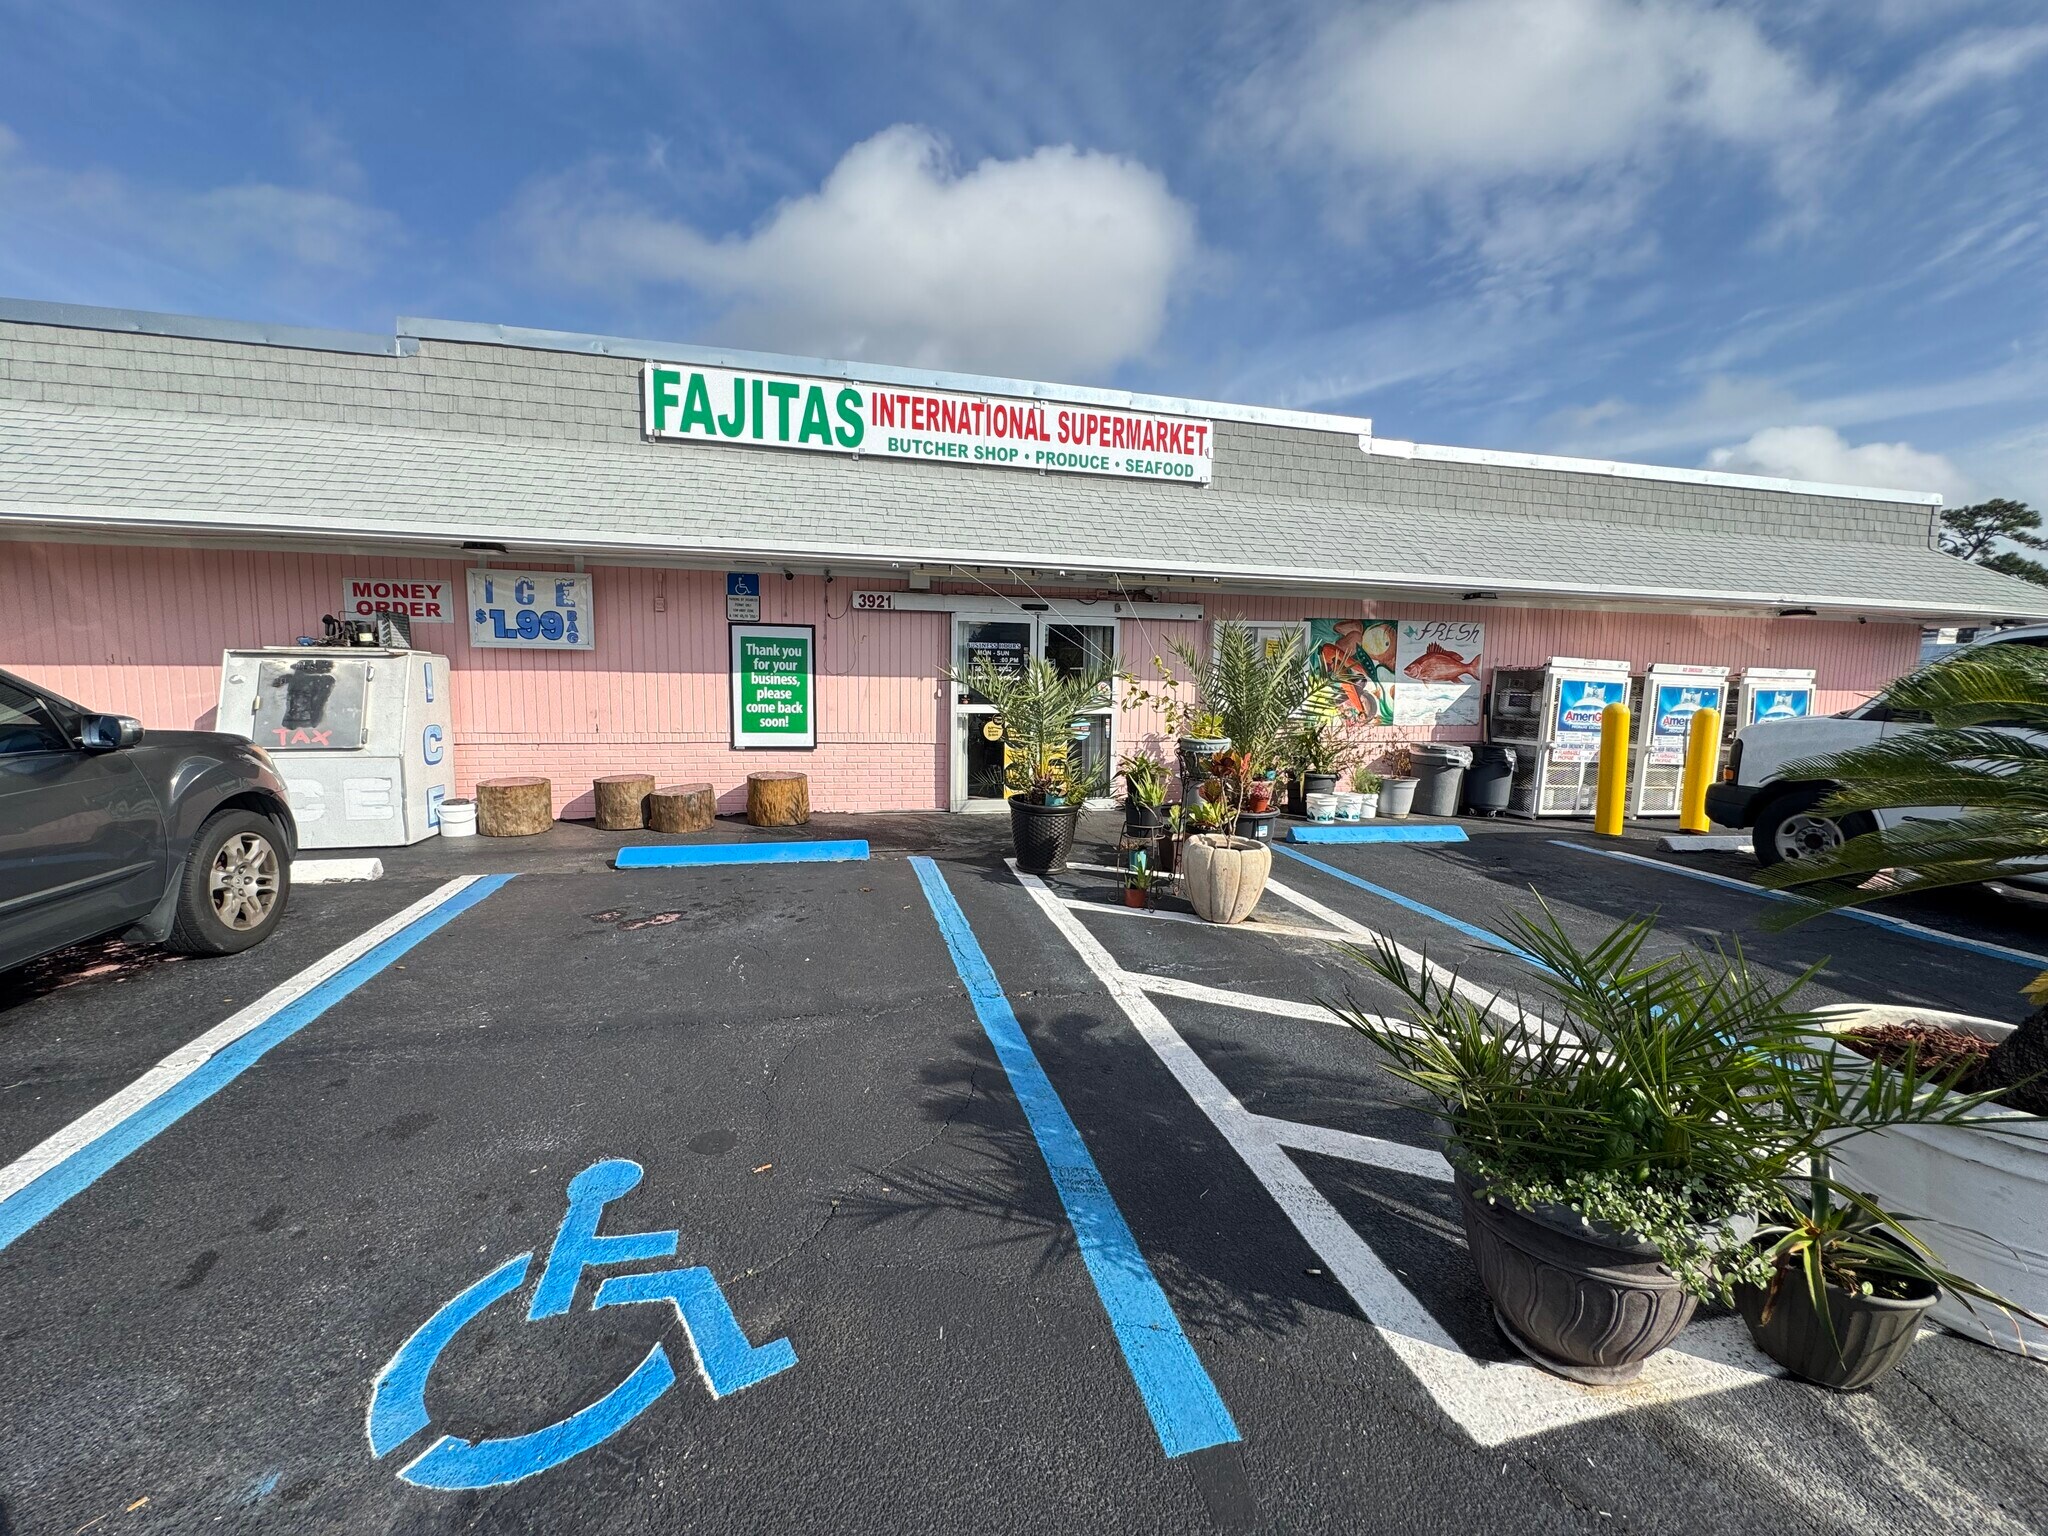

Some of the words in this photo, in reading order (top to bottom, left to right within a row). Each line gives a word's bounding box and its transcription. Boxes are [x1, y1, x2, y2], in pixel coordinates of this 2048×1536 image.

[653, 369, 865, 449] FAJITAS
[872, 392, 1051, 442] INTERNATIONAL
[1057, 410, 1208, 456] SUPERMARKET
[888, 437, 969, 459] BUTCHER
[973, 445, 1019, 462] SHOP
[1035, 450, 1110, 470] PRODUCE
[1125, 458, 1194, 478] SEAFOOD
[352, 582, 442, 599] MONEY
[484, 574, 576, 608] ICE
[356, 600, 442, 618] ORDER
[858, 593, 891, 609] 3921
[566, 610, 579, 644] BAG
[746, 643, 780, 657] Thank
[782, 647, 802, 660] you
[753, 658, 770, 671] for
[773, 661, 798, 673] your
[751, 671, 801, 687] business,
[756, 686, 792, 701] please
[746, 703, 776, 714] come
[777, 701, 803, 714] back
[1565, 710, 1602, 722] AmeriG
[759, 715, 789, 728] soon!
[272, 726, 333, 747] TAX
[422, 662, 446, 829] ICE
